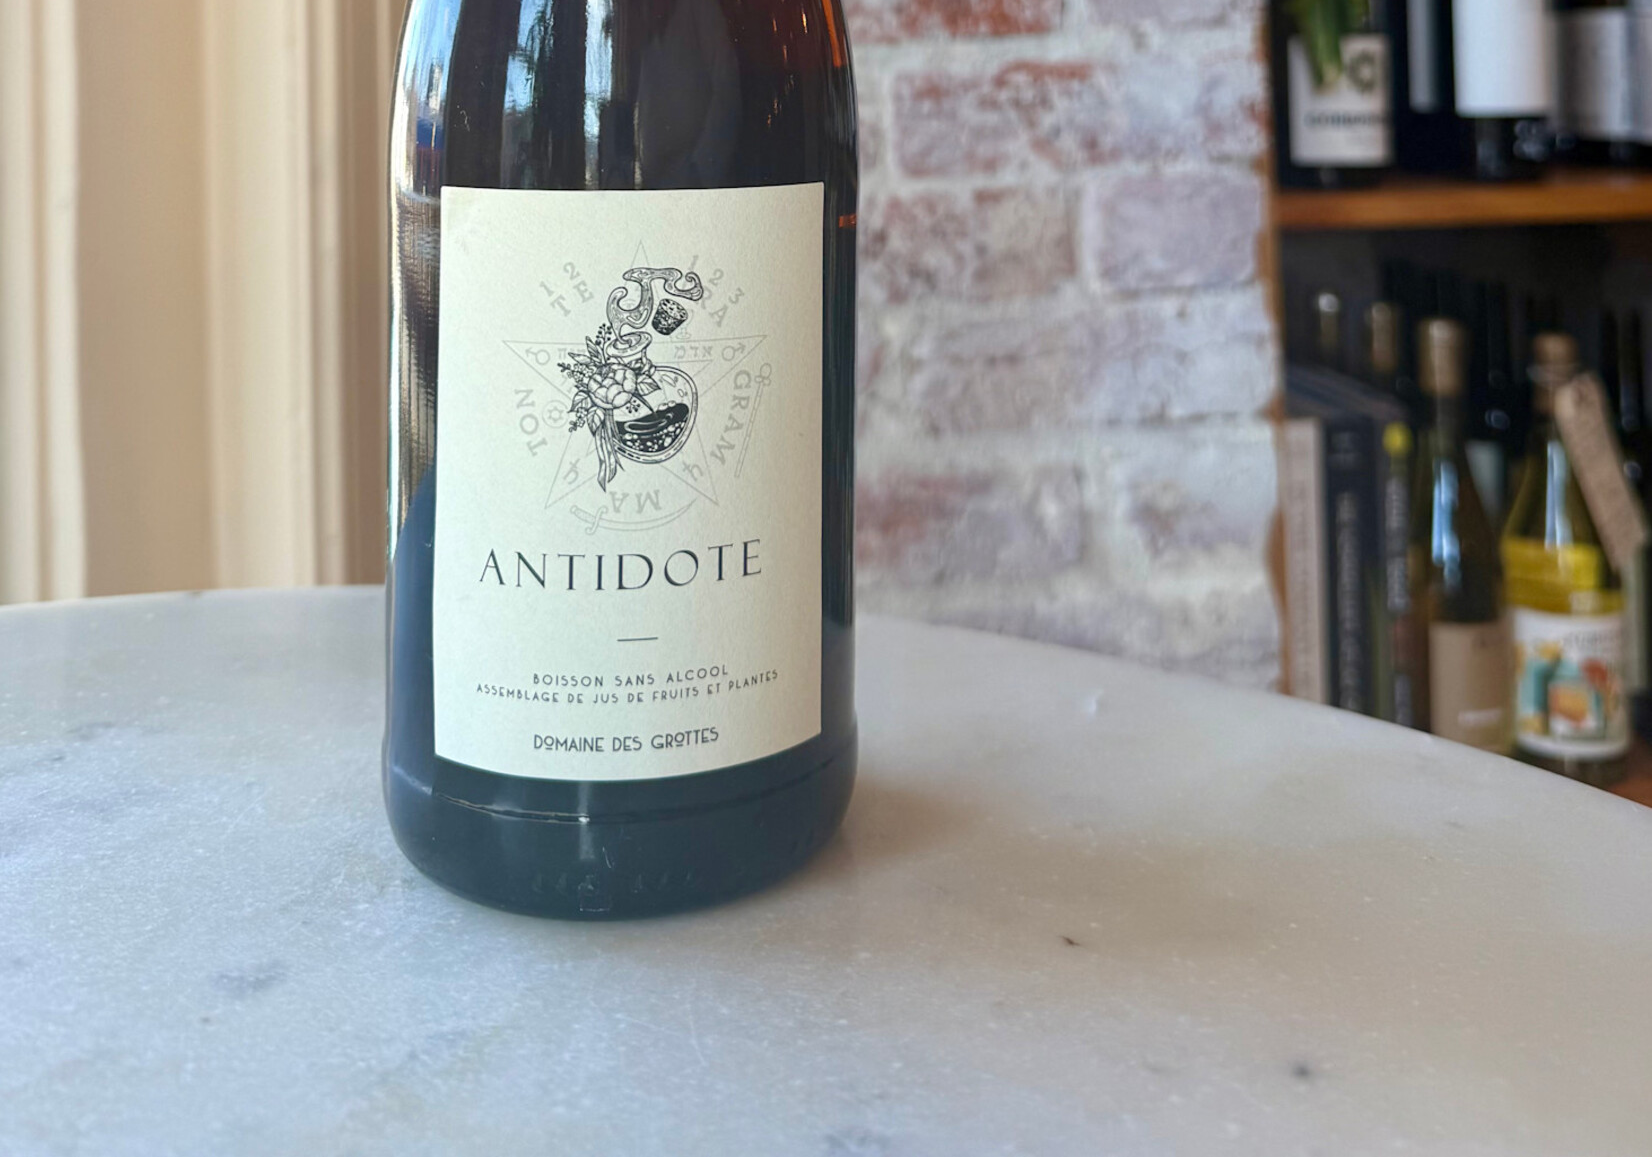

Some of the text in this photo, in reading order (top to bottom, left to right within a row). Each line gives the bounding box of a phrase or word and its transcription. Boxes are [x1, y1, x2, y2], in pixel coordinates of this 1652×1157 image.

[563, 262, 580, 281] 2
[479, 539, 762, 592] ANTIDOTE
[476, 668, 779, 705] ASSEMBLAGE DE JUS DE FRUITS ET PLANTES
[532, 664, 729, 688] BOISSON SANS ALCOOL
[611, 735, 644, 753] DES
